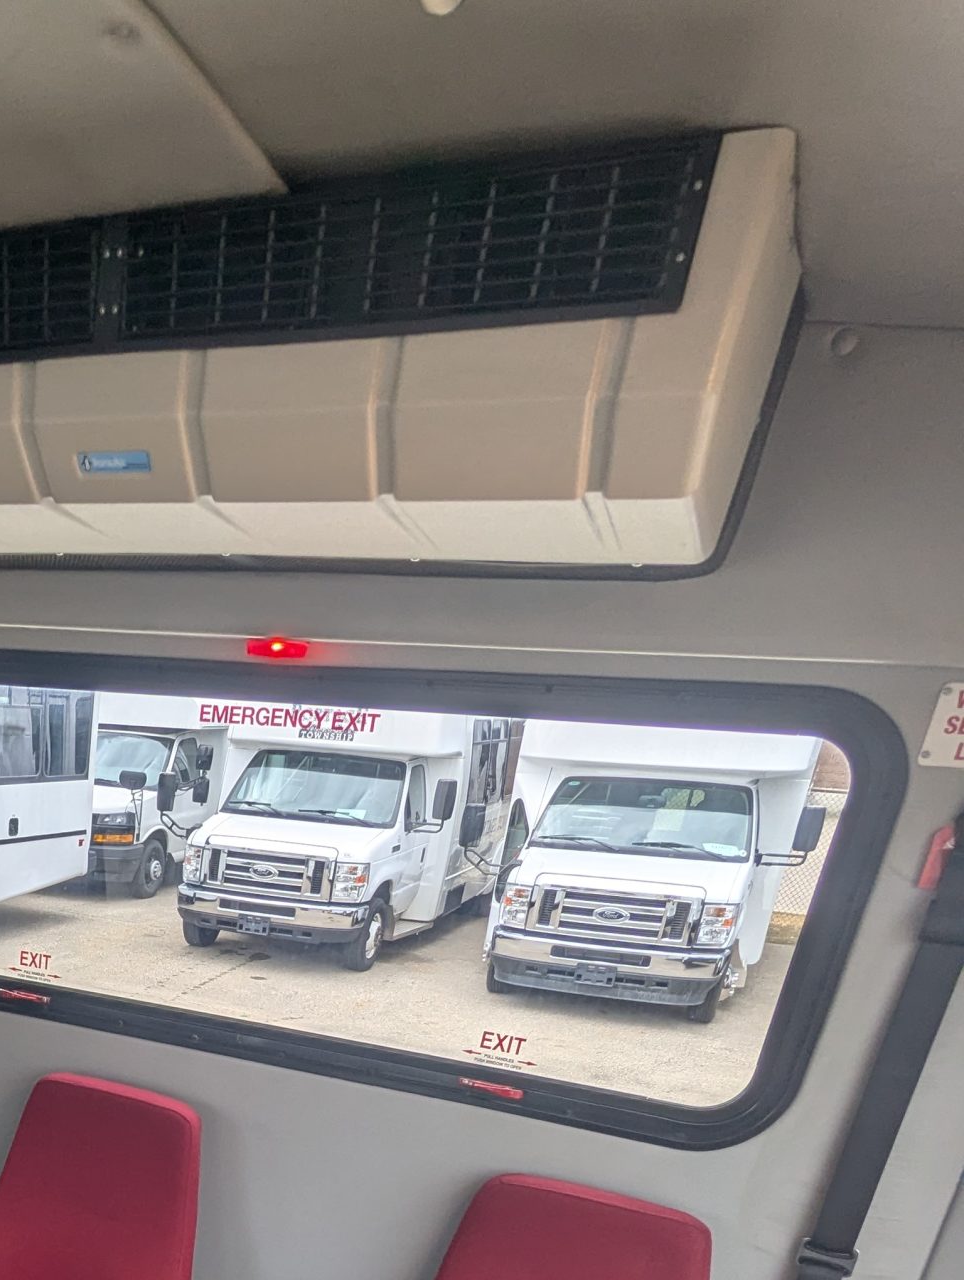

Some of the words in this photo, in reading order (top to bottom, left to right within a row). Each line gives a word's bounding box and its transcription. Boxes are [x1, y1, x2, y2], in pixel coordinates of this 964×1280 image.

[199, 704, 328, 730] EMERGENCY
[331, 710, 381, 733] EXIT
[299, 729, 354, 742] TOWNSHIP
[20, 950, 52, 970] EXIT
[480, 1031, 527, 1055] EXIT
